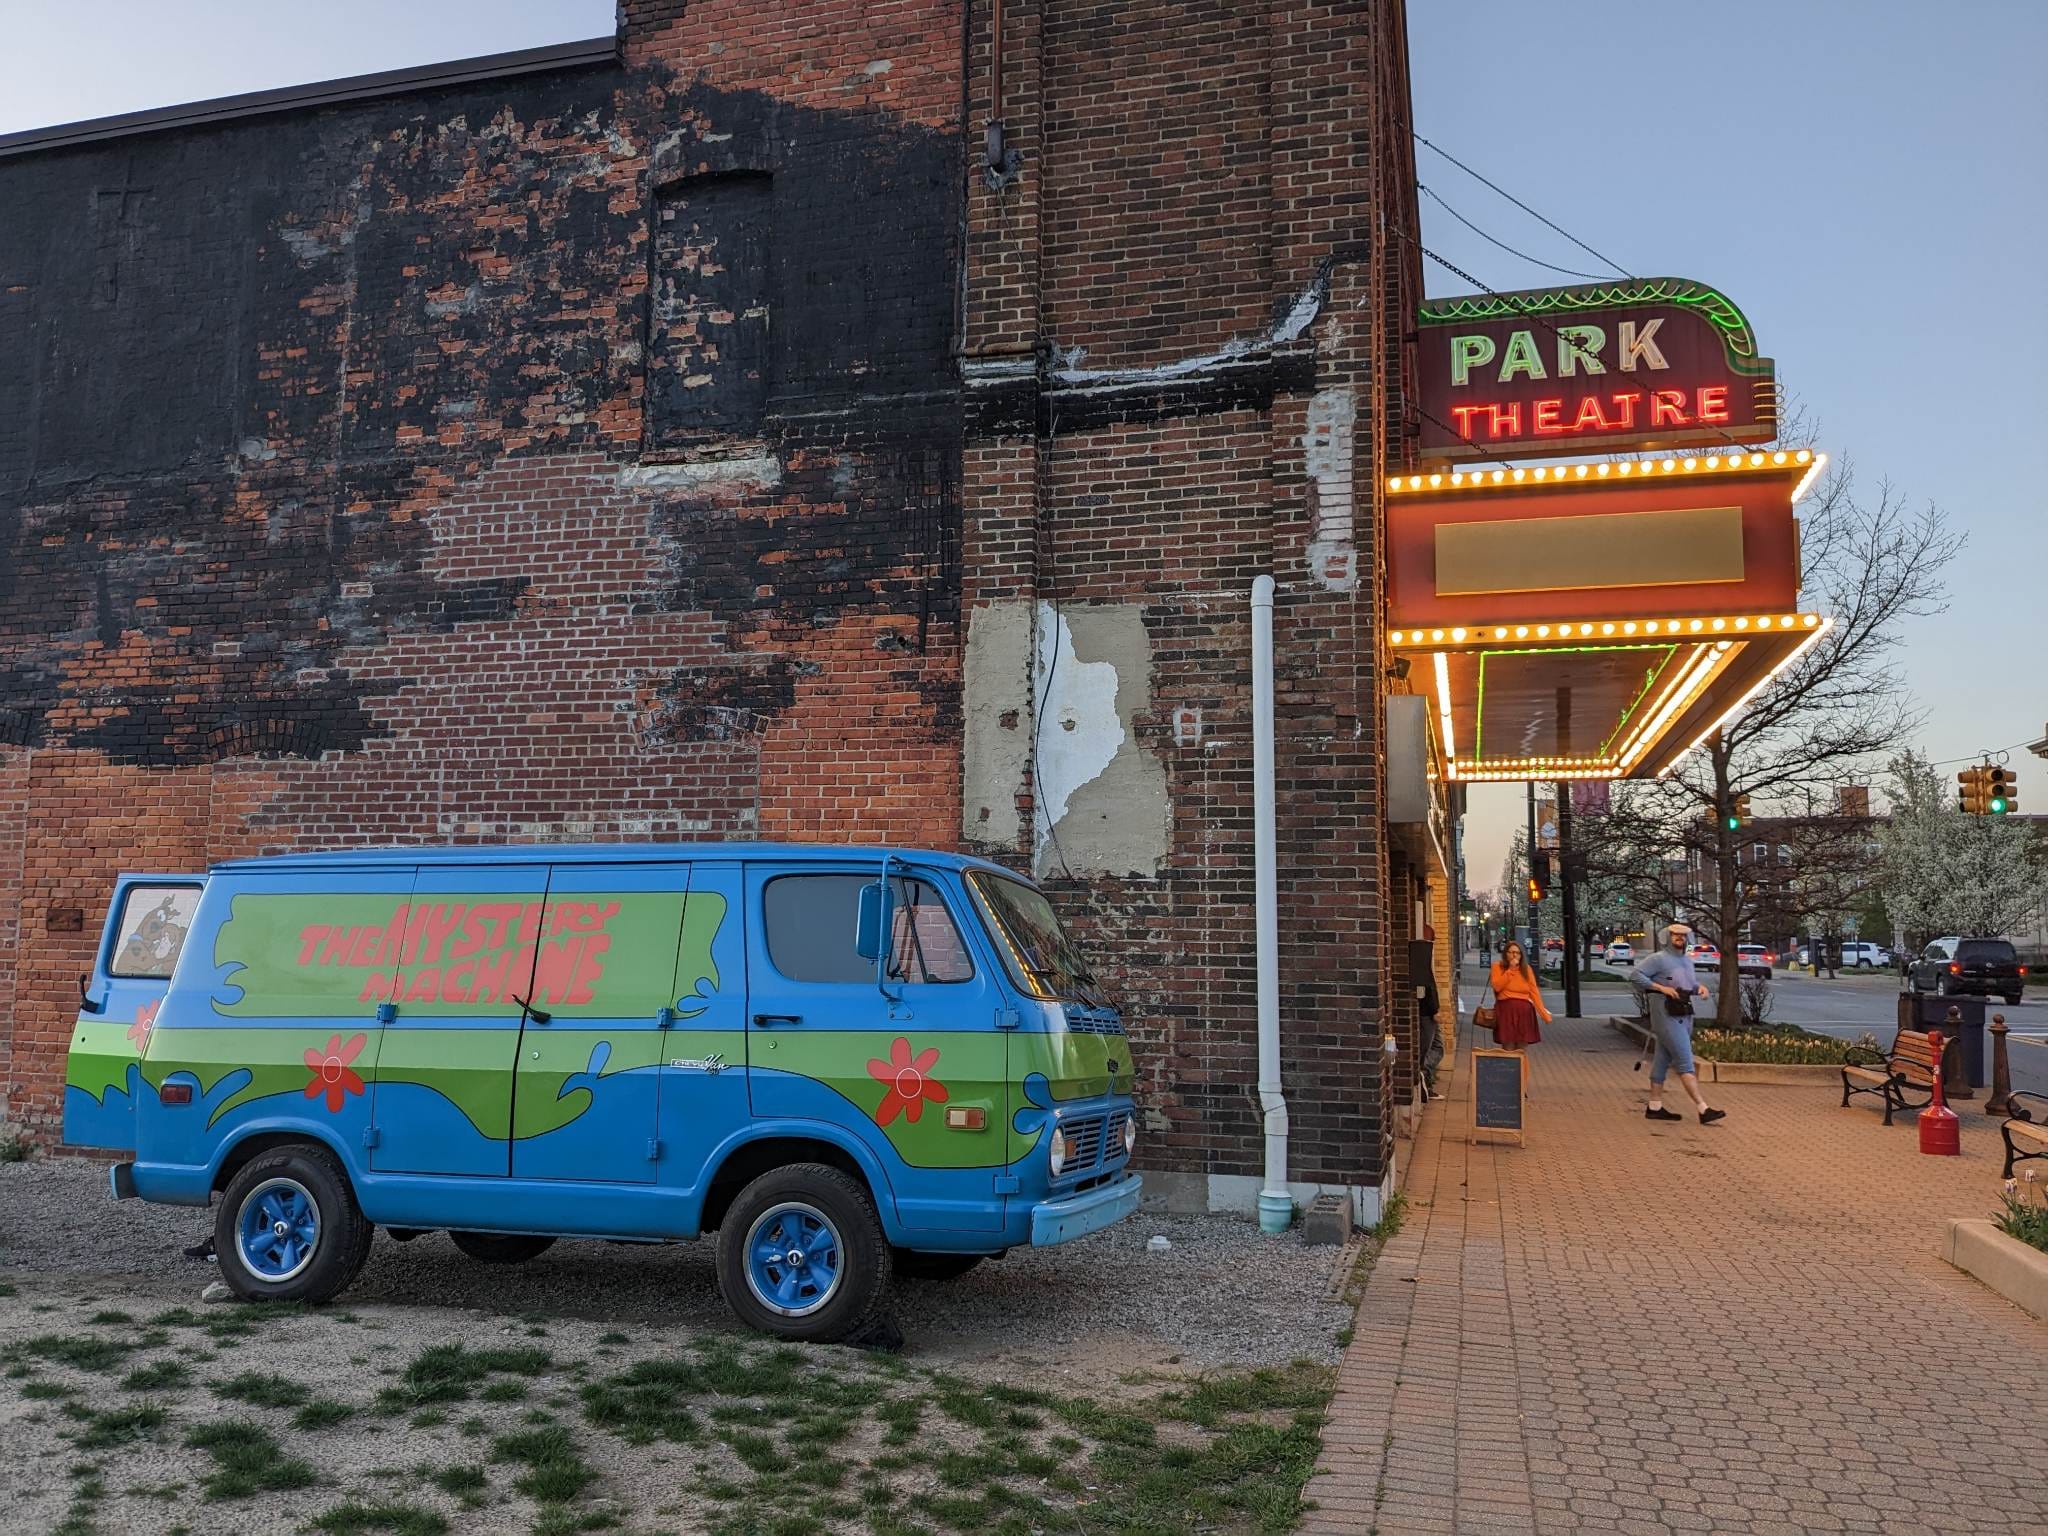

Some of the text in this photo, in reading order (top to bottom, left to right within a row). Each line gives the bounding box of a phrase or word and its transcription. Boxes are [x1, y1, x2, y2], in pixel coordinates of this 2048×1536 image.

[1451, 318, 1670, 386] PARK
[1450, 384, 1730, 440] THEATRE
[296, 901, 621, 967] THE MYSTERY
[357, 933, 611, 1005] MACHINE
